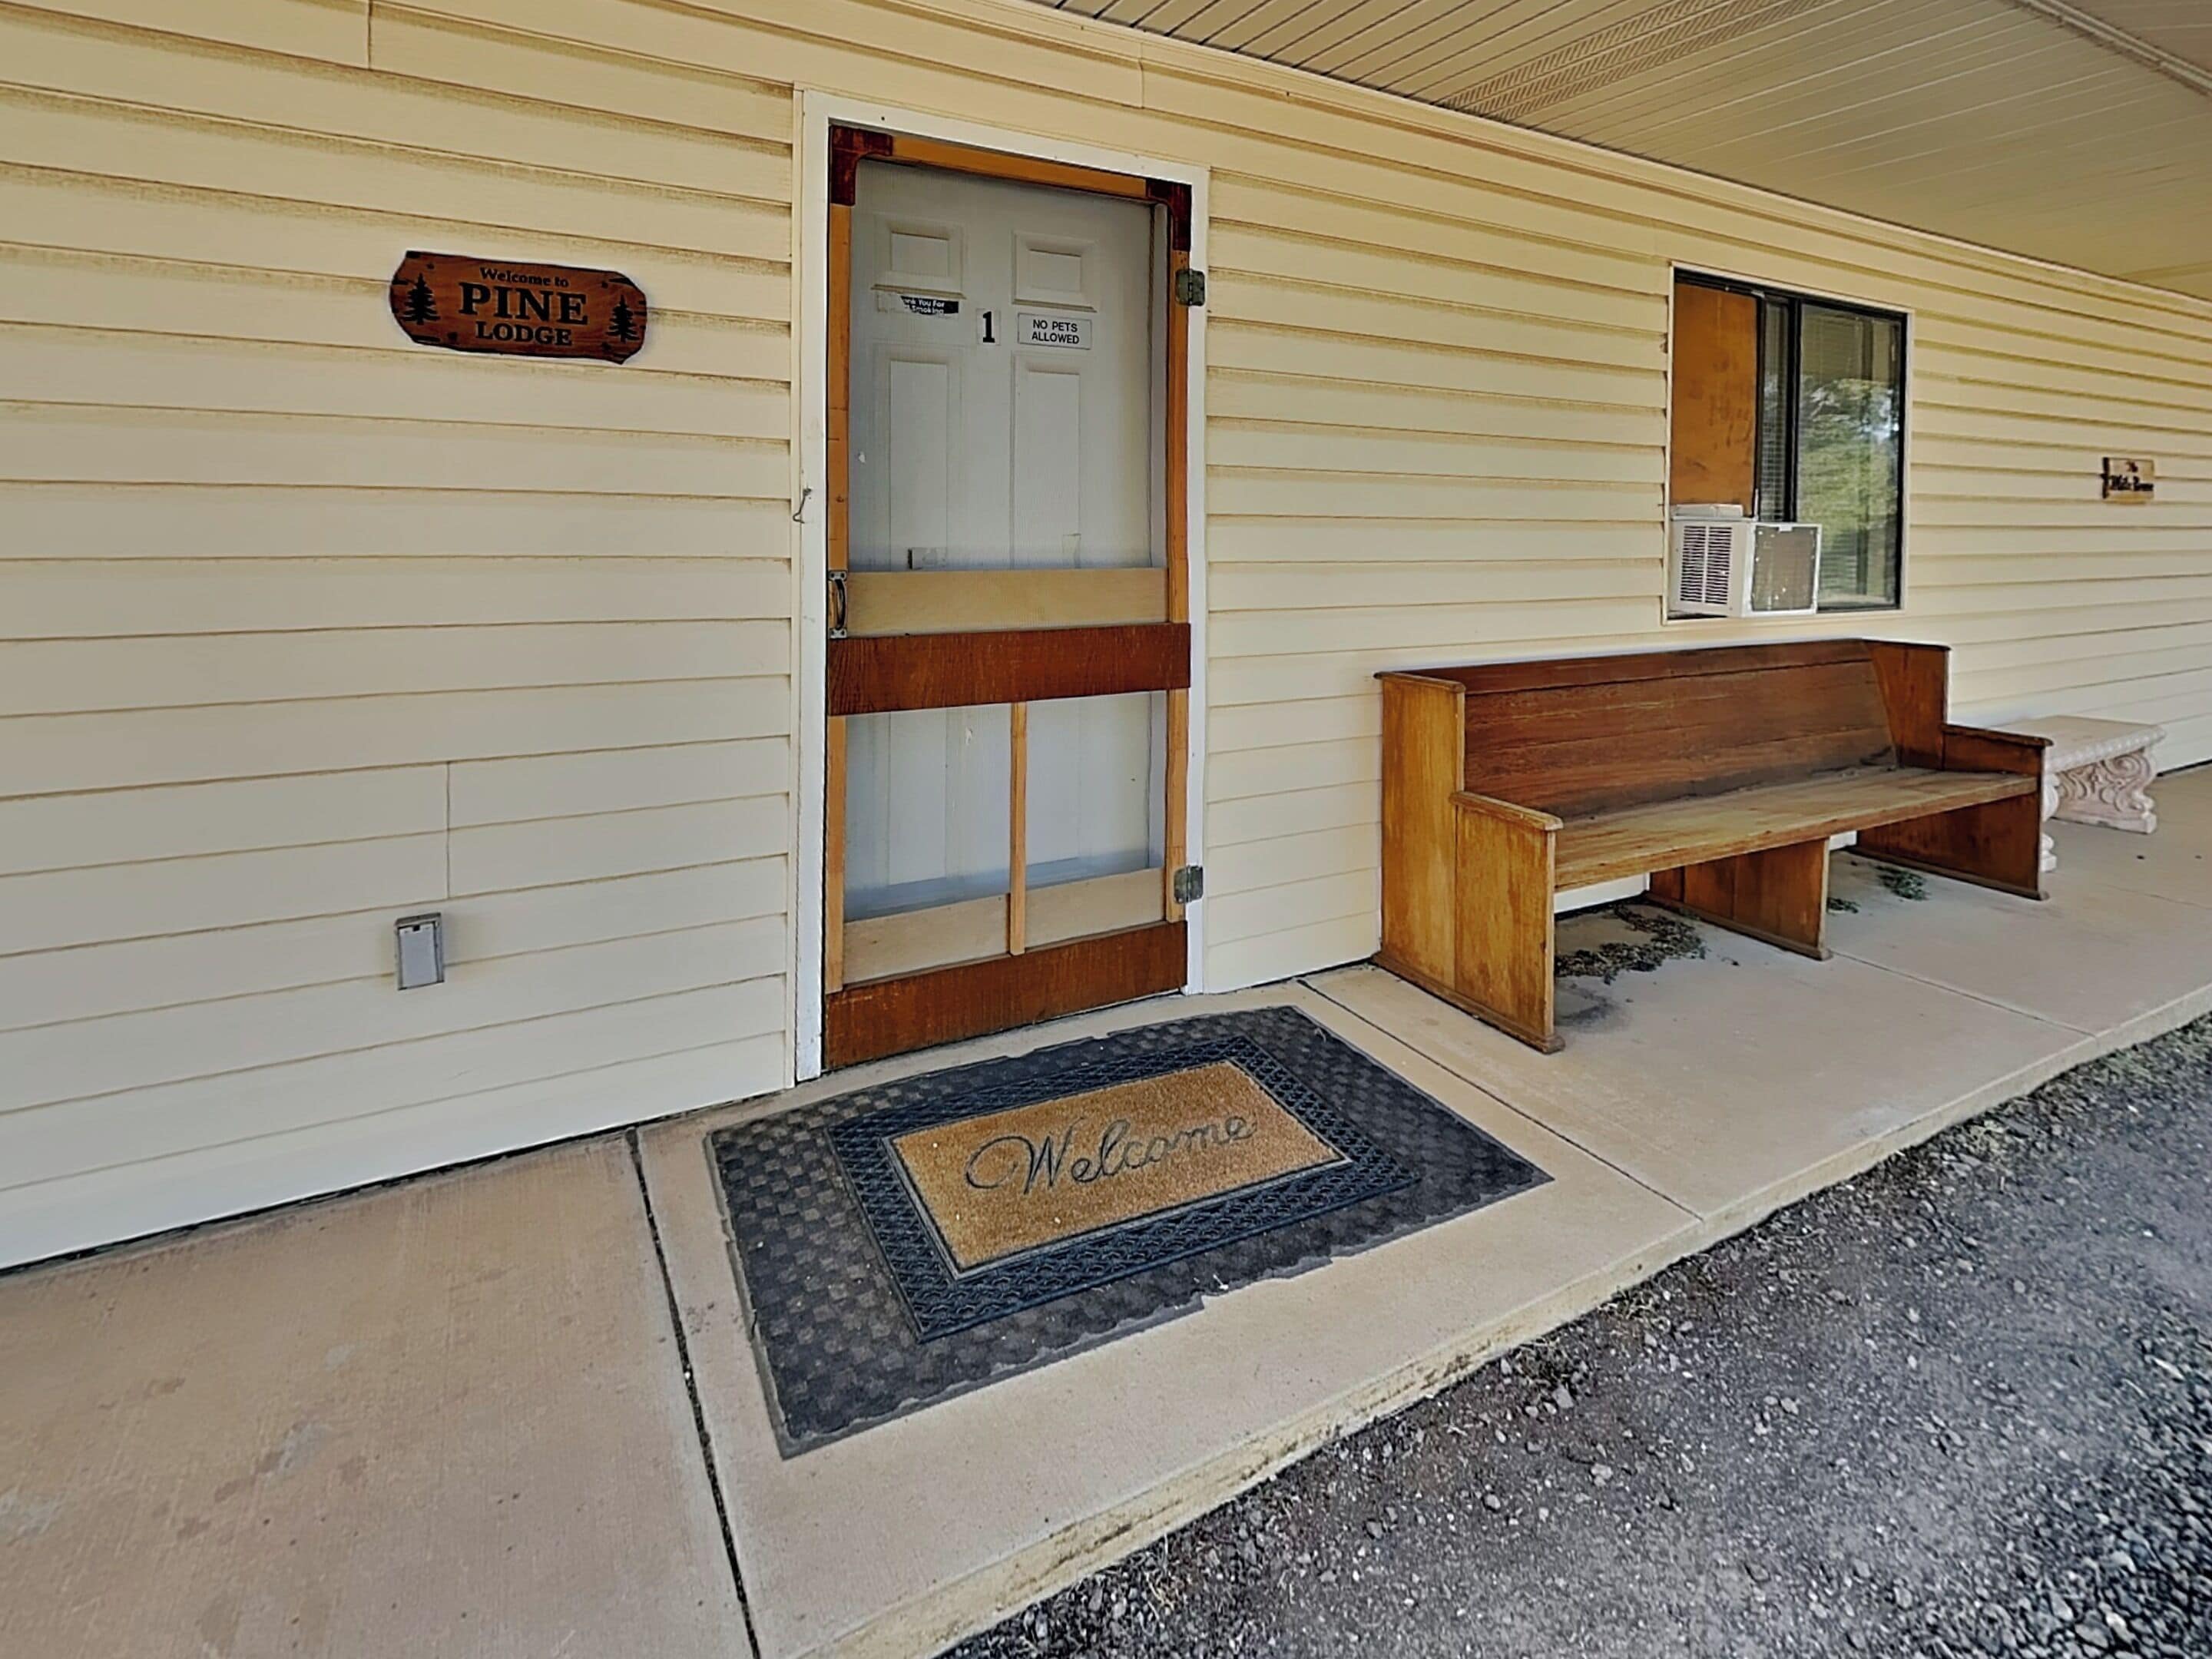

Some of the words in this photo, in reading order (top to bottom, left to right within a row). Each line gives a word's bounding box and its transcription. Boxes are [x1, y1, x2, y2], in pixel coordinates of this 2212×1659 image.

[479, 267, 551, 286] Welcome
[555, 276, 570, 287] to
[459, 282, 588, 325] PINE
[475, 321, 572, 346] LODGE
[982, 310, 996, 343] 1
[1031, 331, 1080, 344] ALLOWED
[1032, 319, 1048, 329] NO
[1051, 320, 1078, 333] PETS
[965, 1115, 1258, 1195] Welcome
